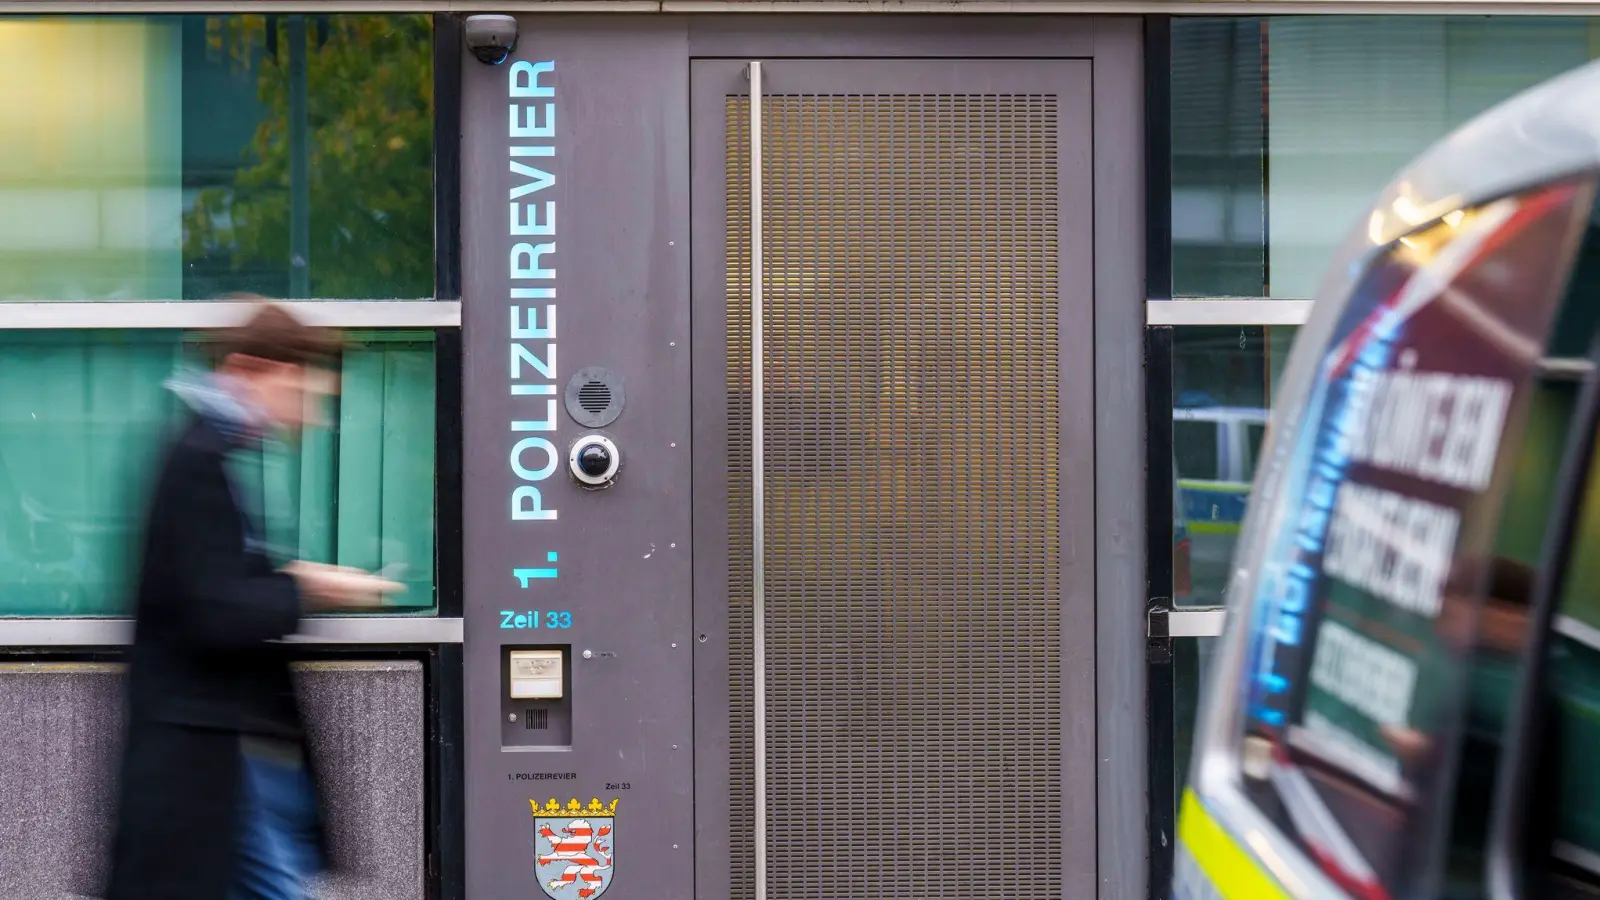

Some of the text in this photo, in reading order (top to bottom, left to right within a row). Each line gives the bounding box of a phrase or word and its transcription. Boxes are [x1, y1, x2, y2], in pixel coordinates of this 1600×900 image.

[508, 59, 559, 588] 1. POLIZEIREVIER
[499, 610, 573, 629] Zeil 33
[507, 773, 514, 781] 1.
